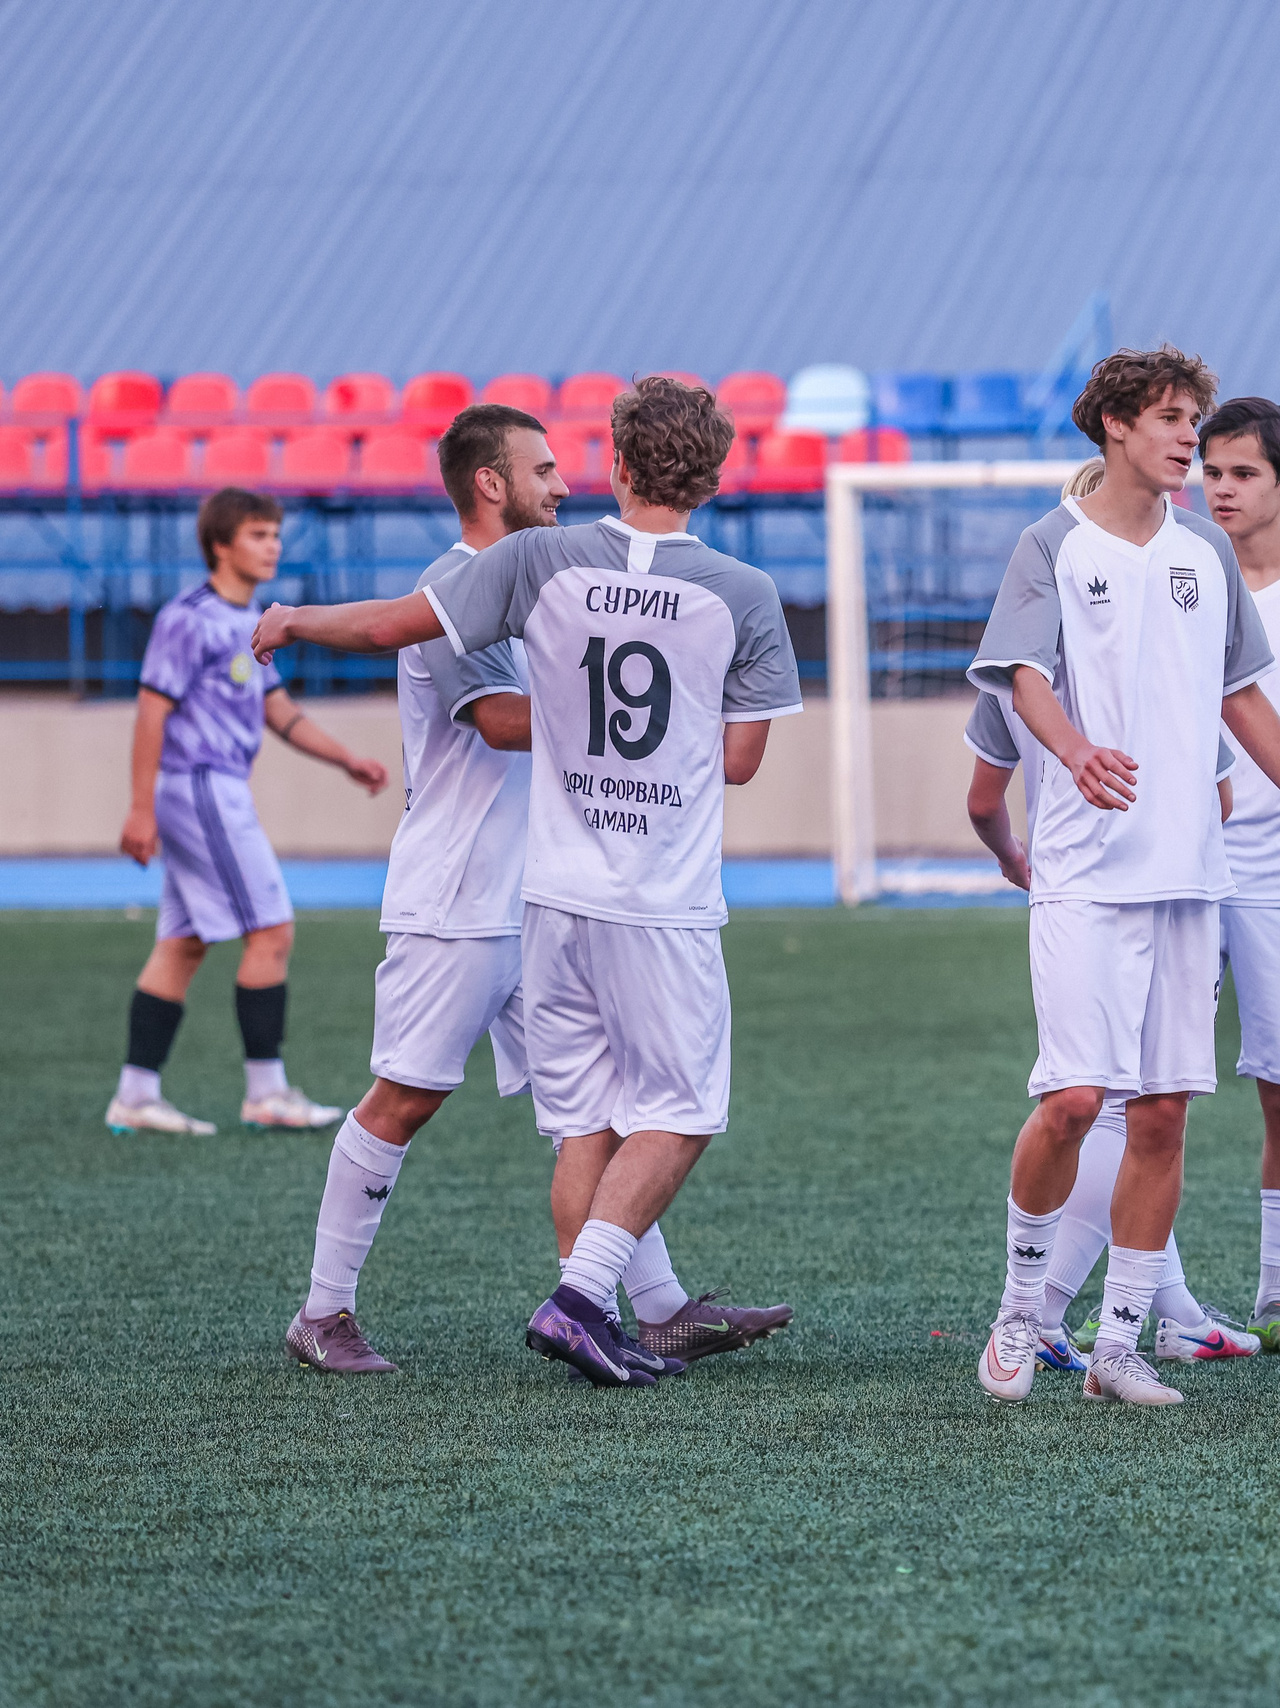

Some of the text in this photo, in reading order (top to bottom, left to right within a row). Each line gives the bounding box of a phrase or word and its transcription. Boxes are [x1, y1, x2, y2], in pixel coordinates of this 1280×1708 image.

[585, 585, 680, 621] СУРИН
[579, 636, 672, 761] 19
[563, 770, 683, 808] ДФЦ ФОРВАРД
[583, 808, 648, 835] САМАРА
